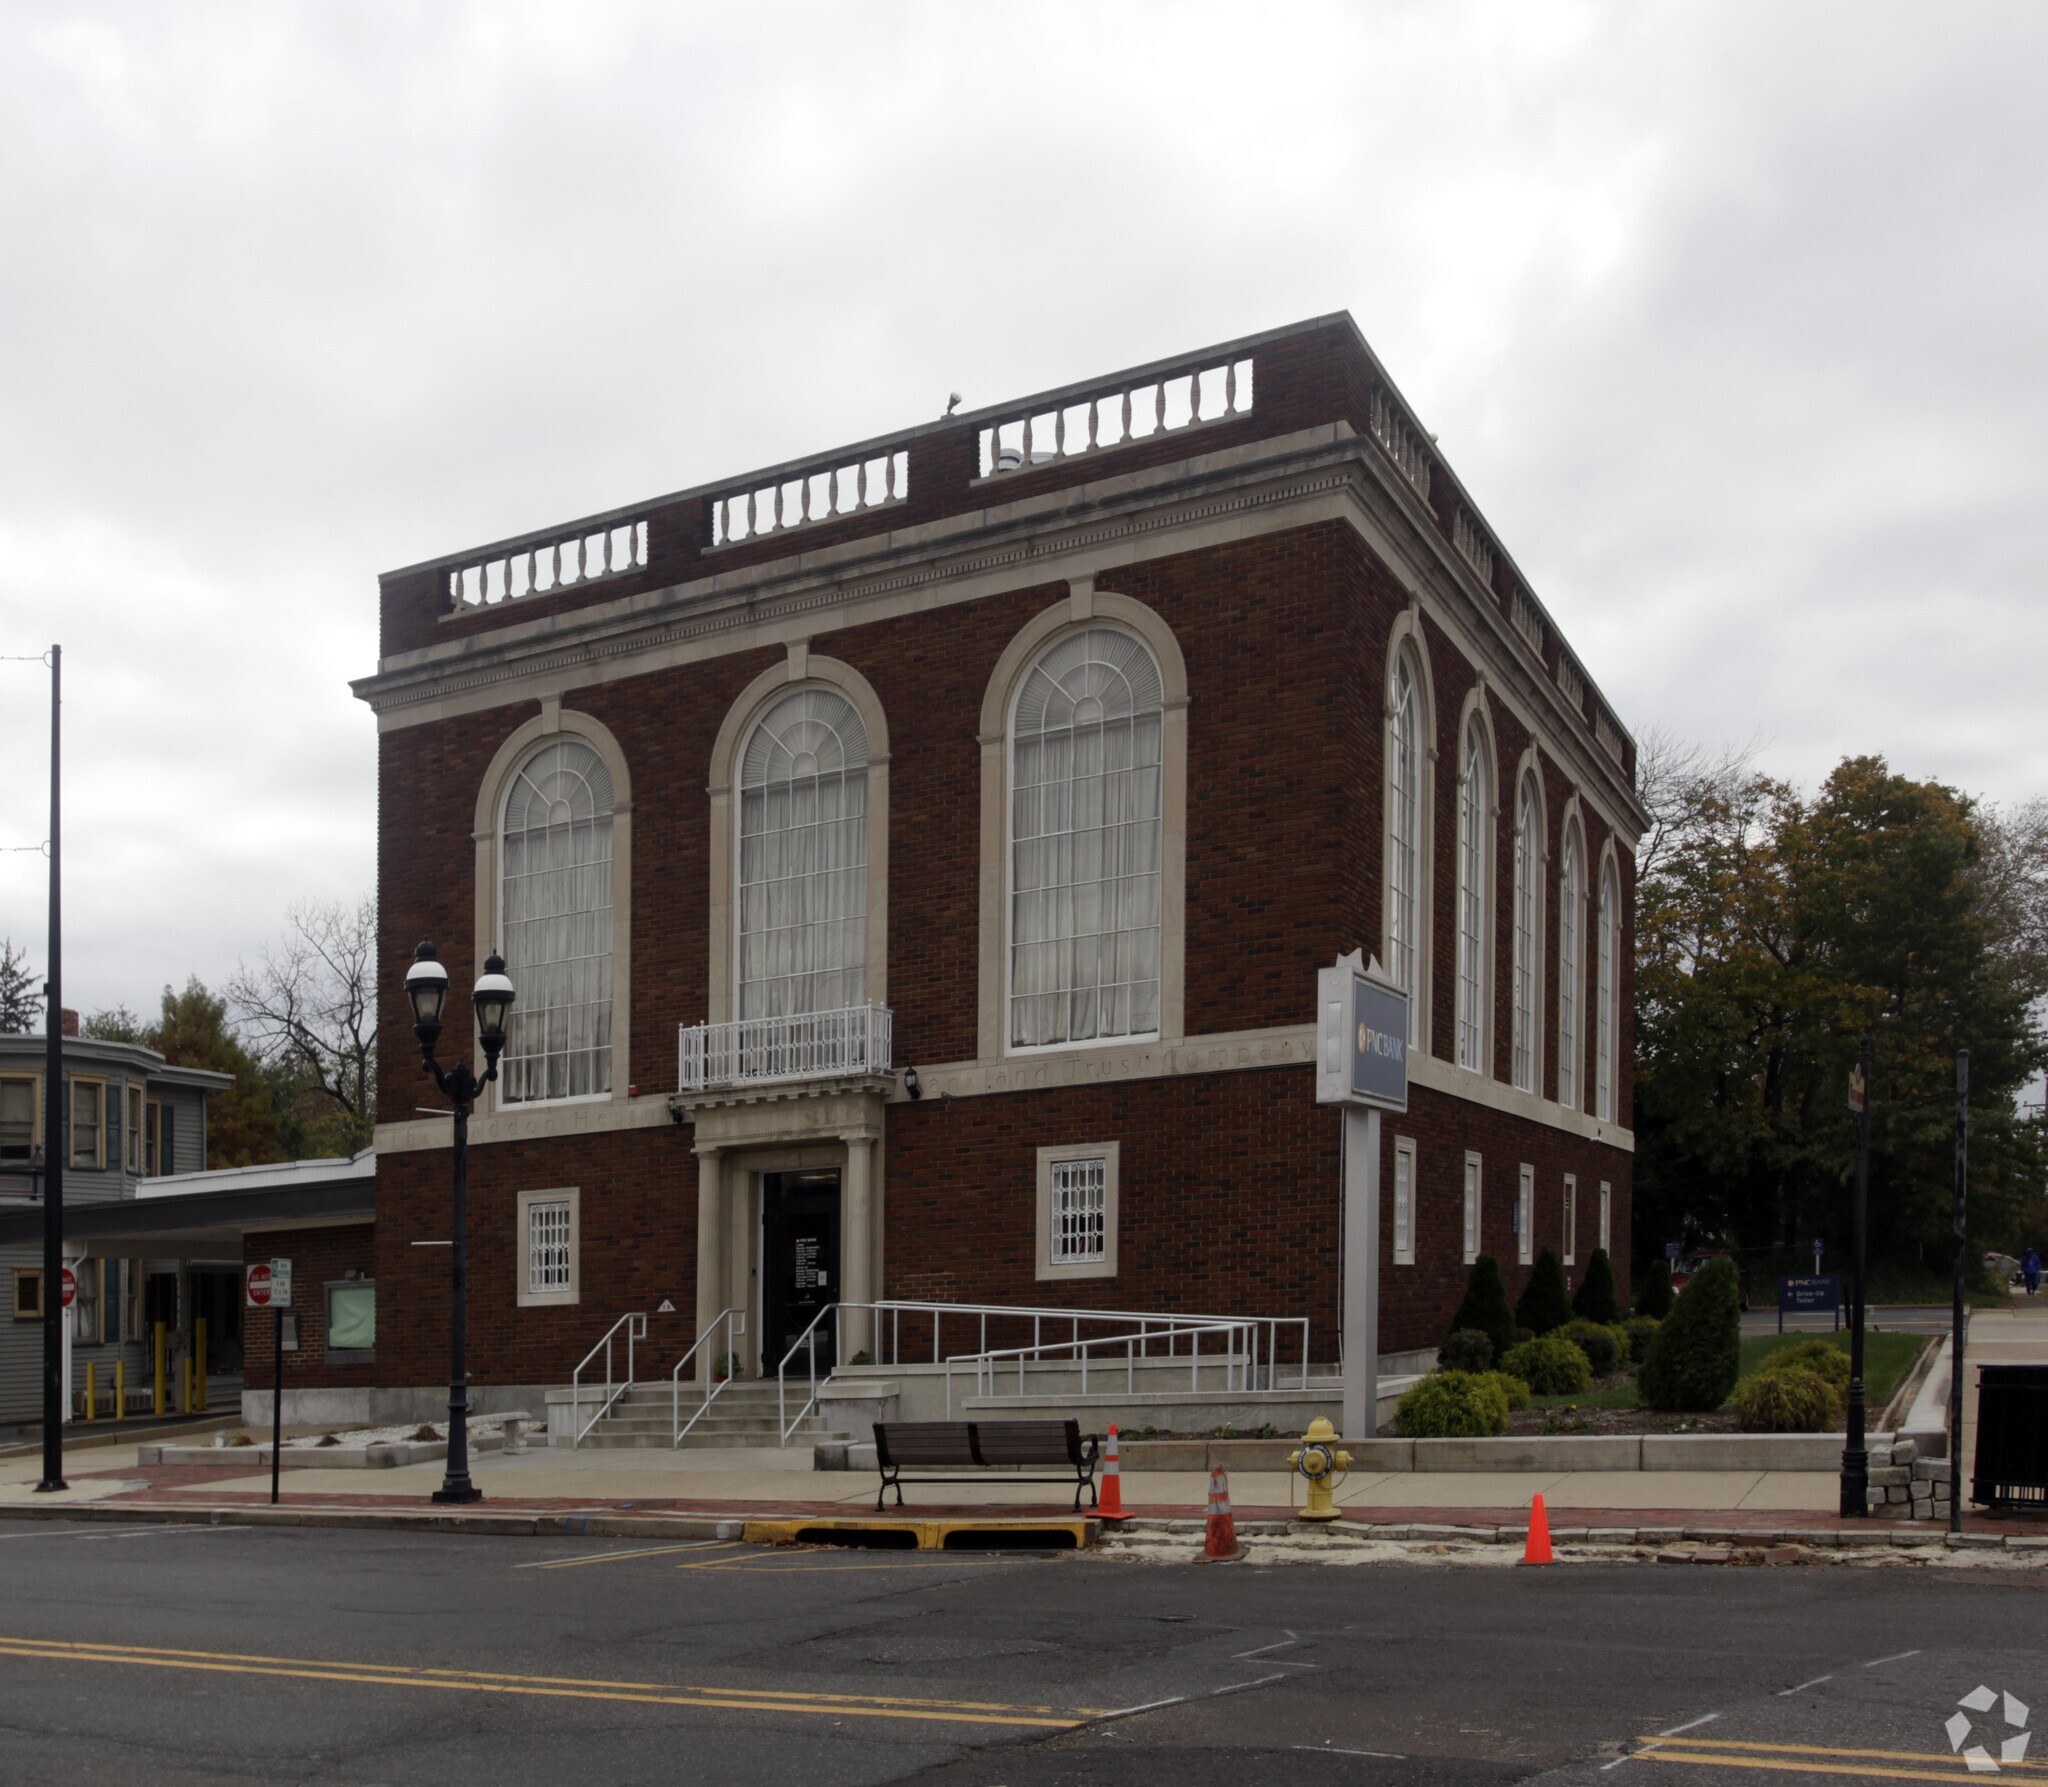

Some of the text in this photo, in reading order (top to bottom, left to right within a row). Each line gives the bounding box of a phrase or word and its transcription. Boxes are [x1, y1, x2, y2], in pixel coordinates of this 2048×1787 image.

[449, 1117, 555, 1143] addon
[926, 1071, 975, 1094] ank
[995, 1062, 1048, 1087] and
[1065, 1055, 1148, 1078] Trust
[1164, 1038, 1314, 1070] Company
